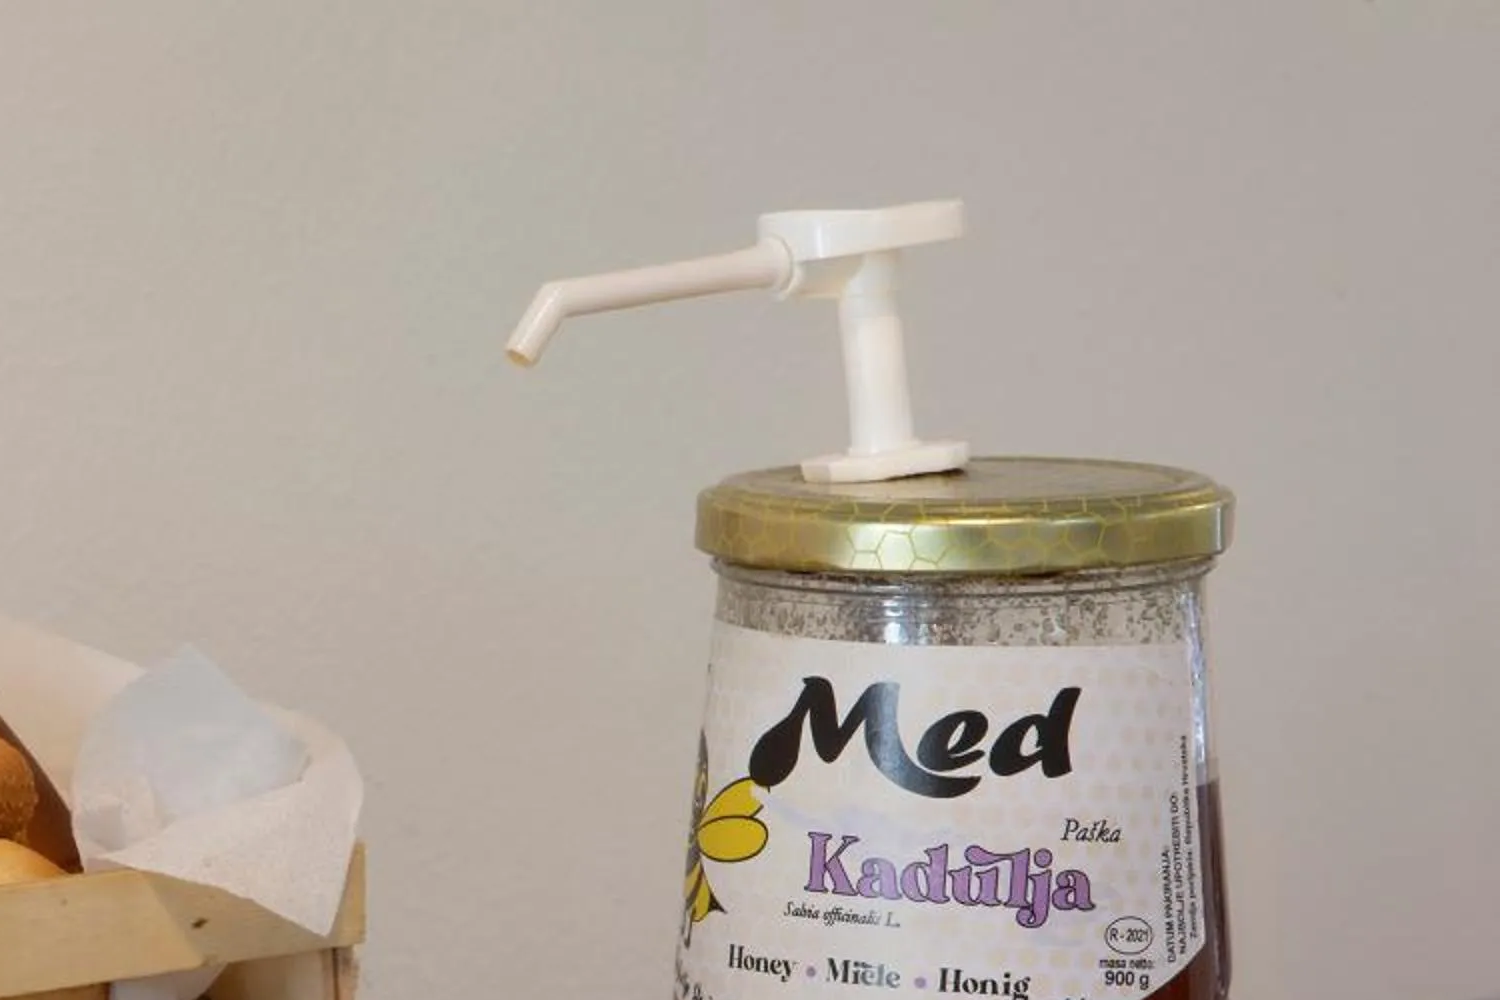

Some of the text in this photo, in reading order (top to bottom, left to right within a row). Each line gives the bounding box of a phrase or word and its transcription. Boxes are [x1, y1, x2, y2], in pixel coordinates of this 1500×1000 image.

[749, 676, 1081, 799] Med
[1060, 817, 1122, 843] Paška
[804, 831, 1097, 928] Kadulja
[729, 943, 793, 982] Honey
[1105, 971, 1149, 990] 900 g
